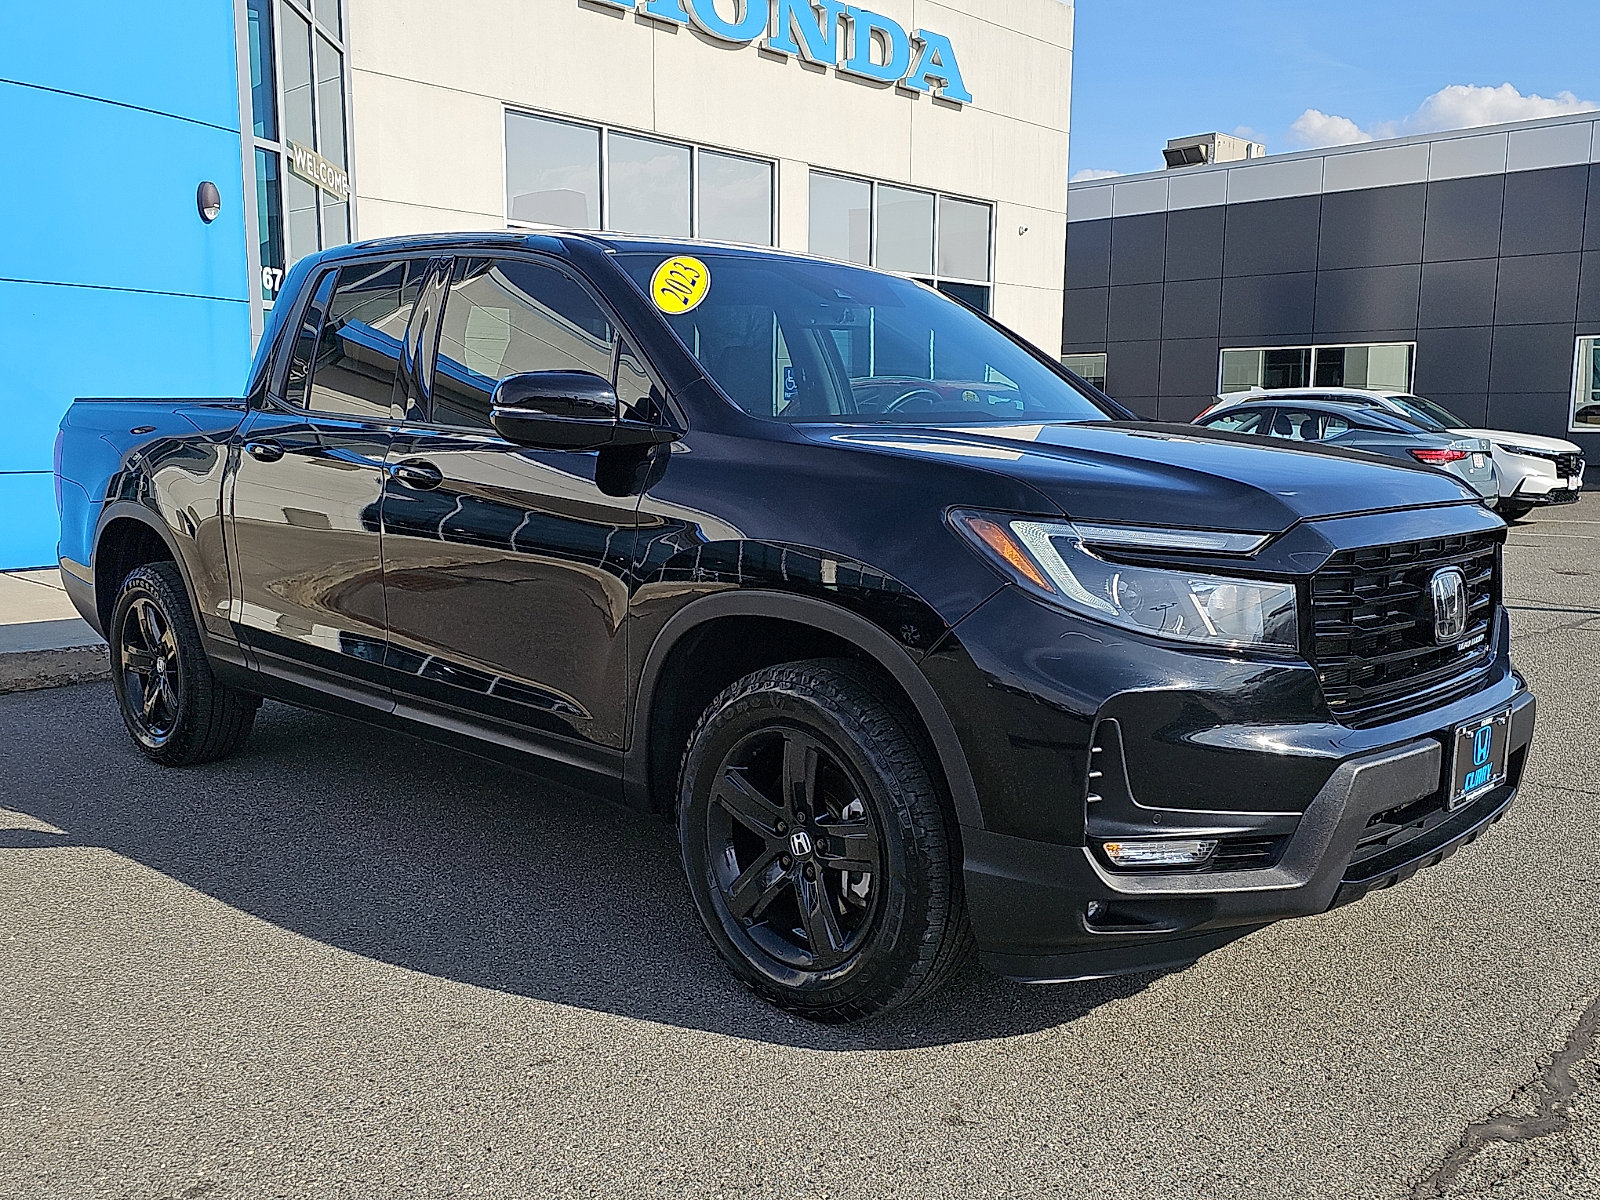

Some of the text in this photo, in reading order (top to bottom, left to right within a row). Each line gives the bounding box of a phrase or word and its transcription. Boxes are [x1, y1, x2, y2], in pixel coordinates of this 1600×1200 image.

[600, 0, 973, 104] ONDA
[293, 144, 349, 195] WELCOME
[260, 265, 283, 292] 67
[660, 261, 701, 306] 2023
[1464, 761, 1493, 791] CURRY
